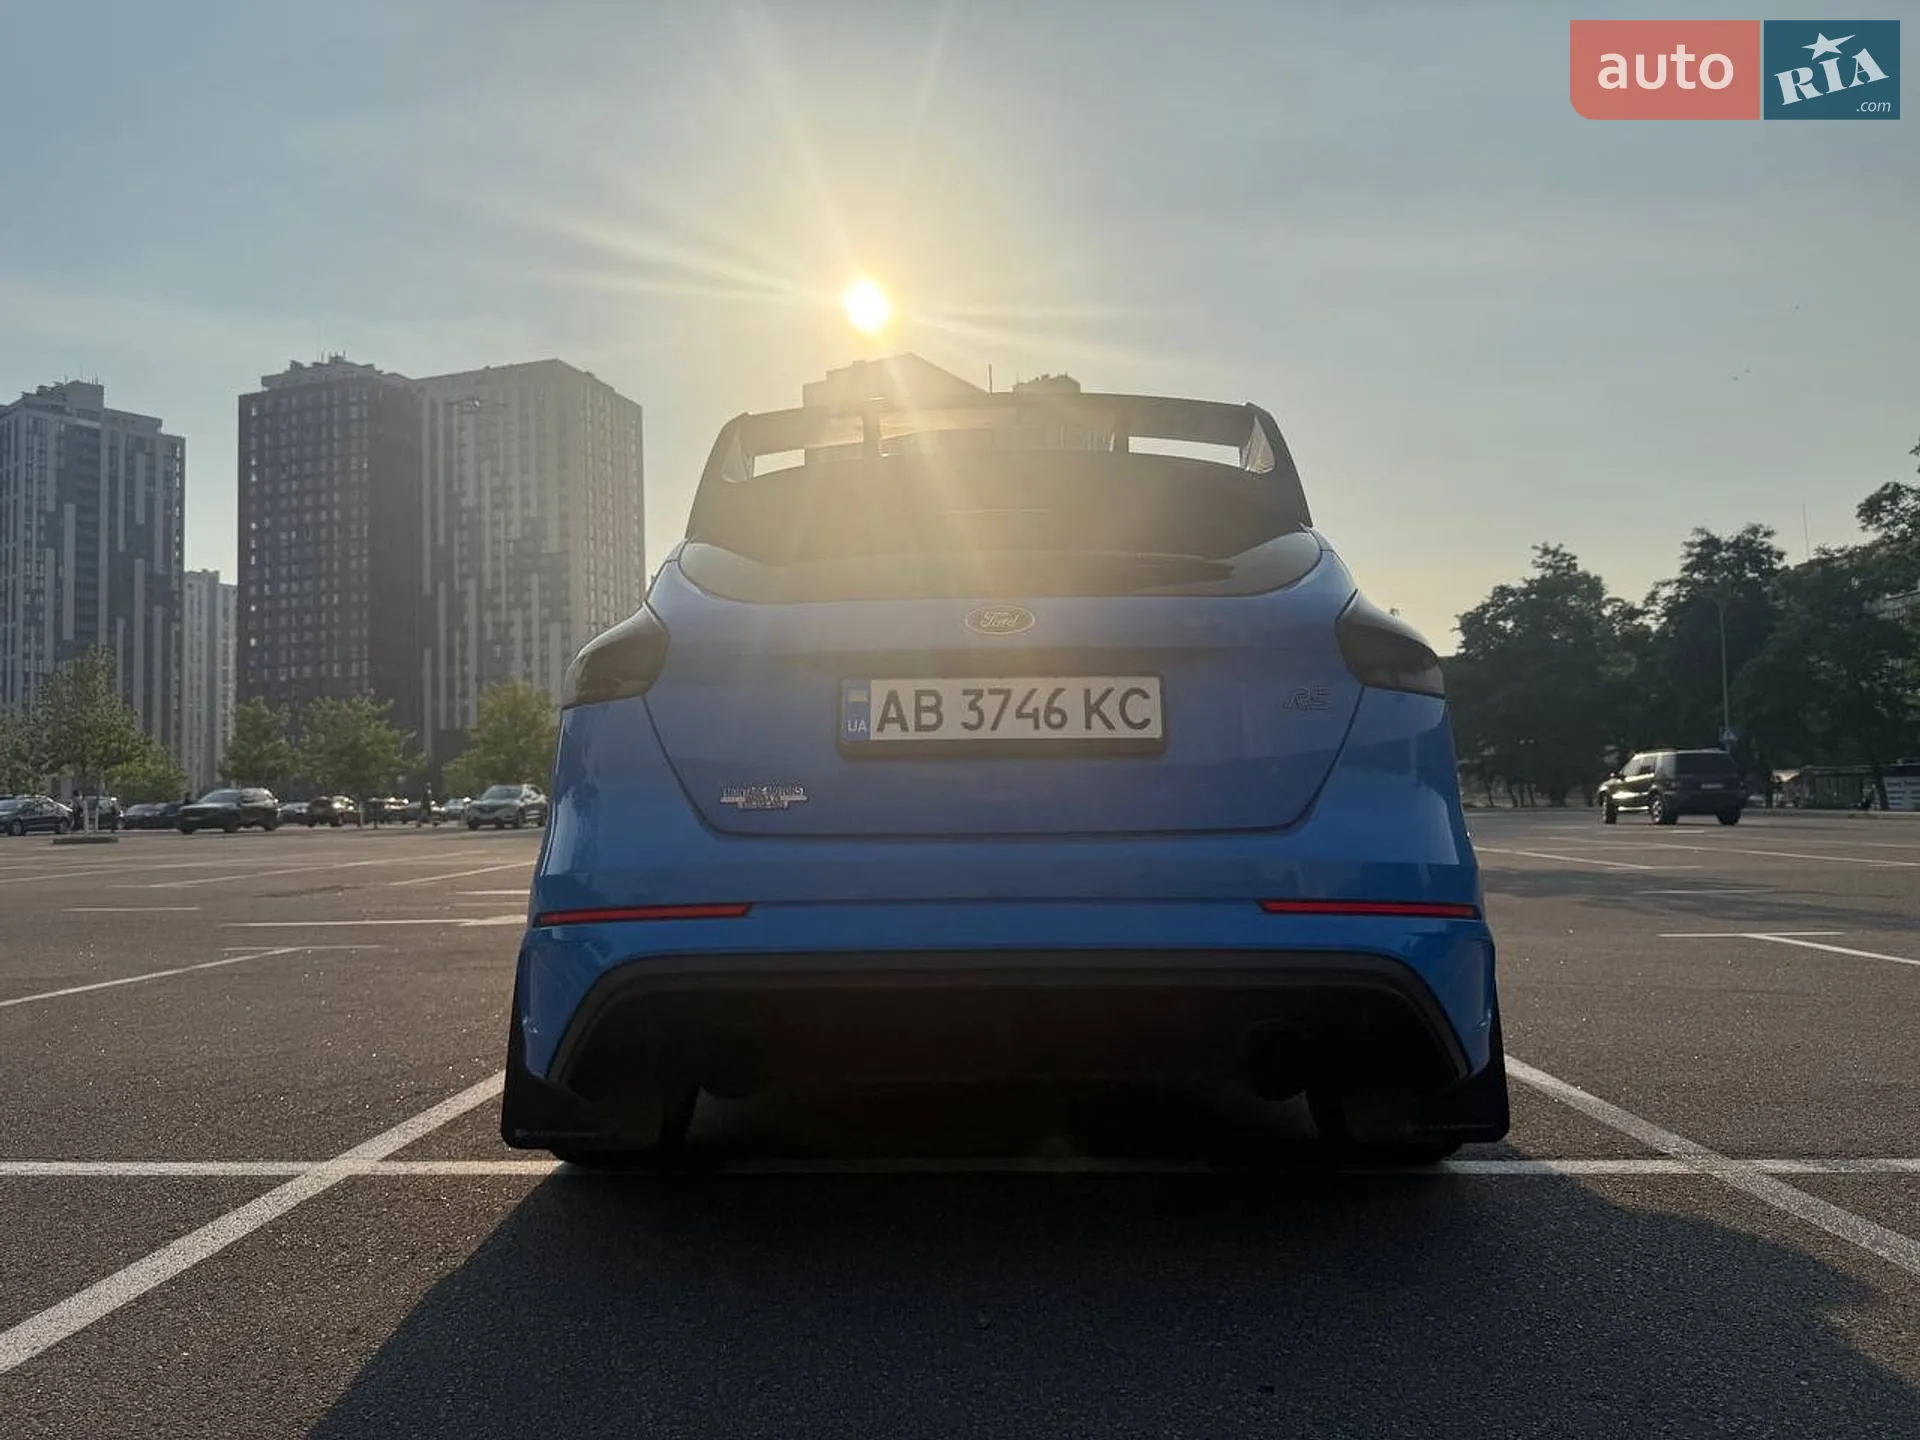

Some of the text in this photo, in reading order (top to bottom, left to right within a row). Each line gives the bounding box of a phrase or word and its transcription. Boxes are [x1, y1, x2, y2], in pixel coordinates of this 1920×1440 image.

[980, 610, 1021, 629] Ford
[876, 686, 1152, 733] AB 3746 KC
[847, 719, 868, 733] UA
